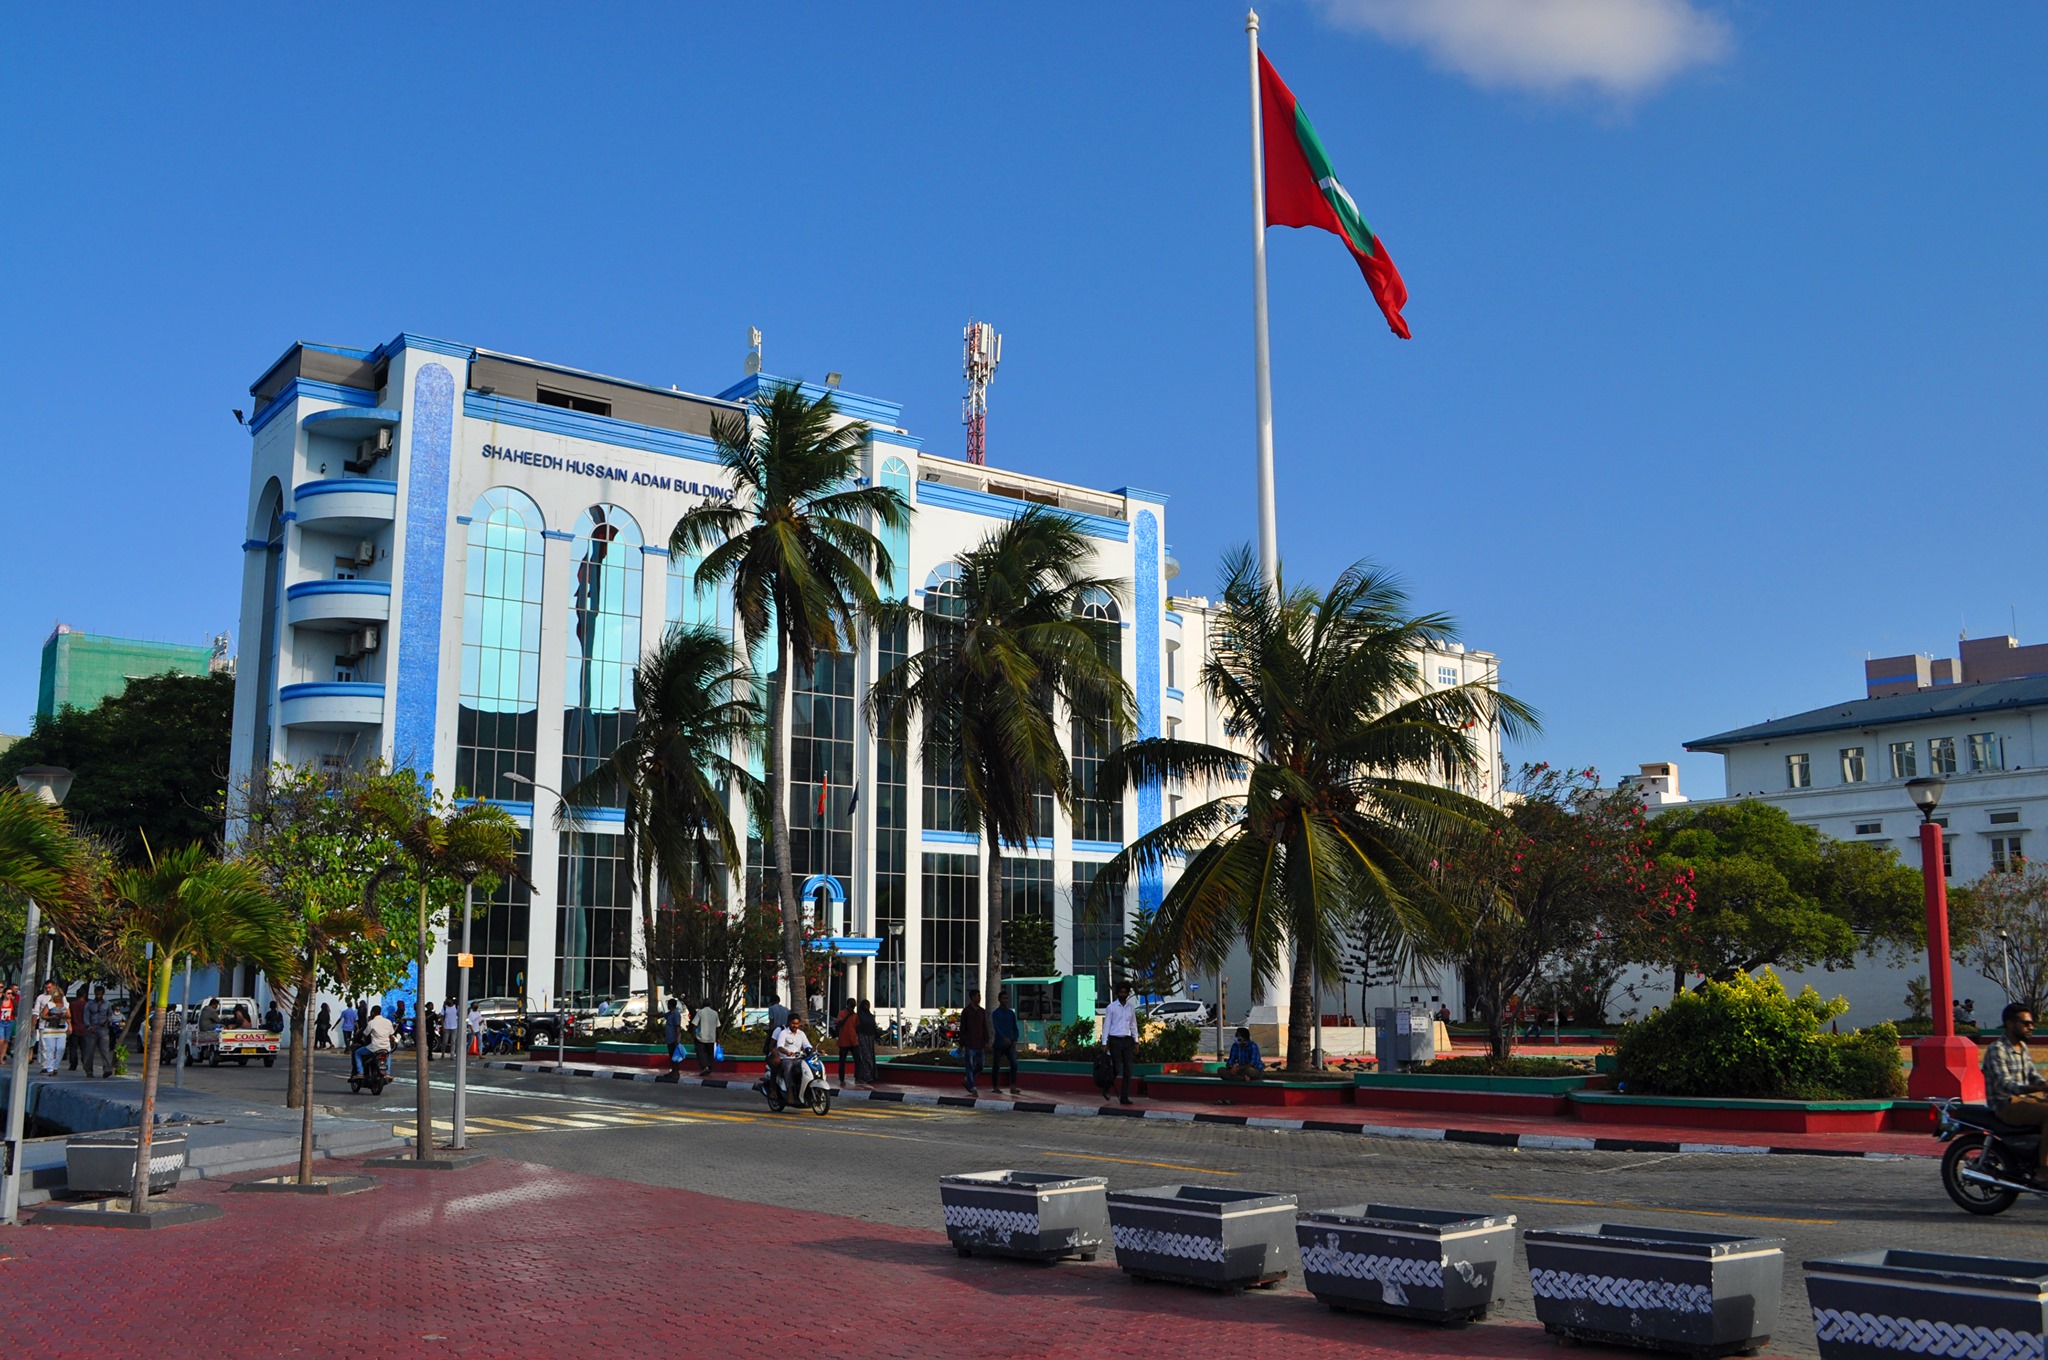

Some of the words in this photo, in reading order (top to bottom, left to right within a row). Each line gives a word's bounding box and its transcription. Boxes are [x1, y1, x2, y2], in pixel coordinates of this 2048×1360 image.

[482, 444, 562, 471] SHAHEEDH
[566, 459, 628, 483] HUSSAIN
[631, 472, 671, 490] ADAM
[674, 479, 734, 500] BUILDING
